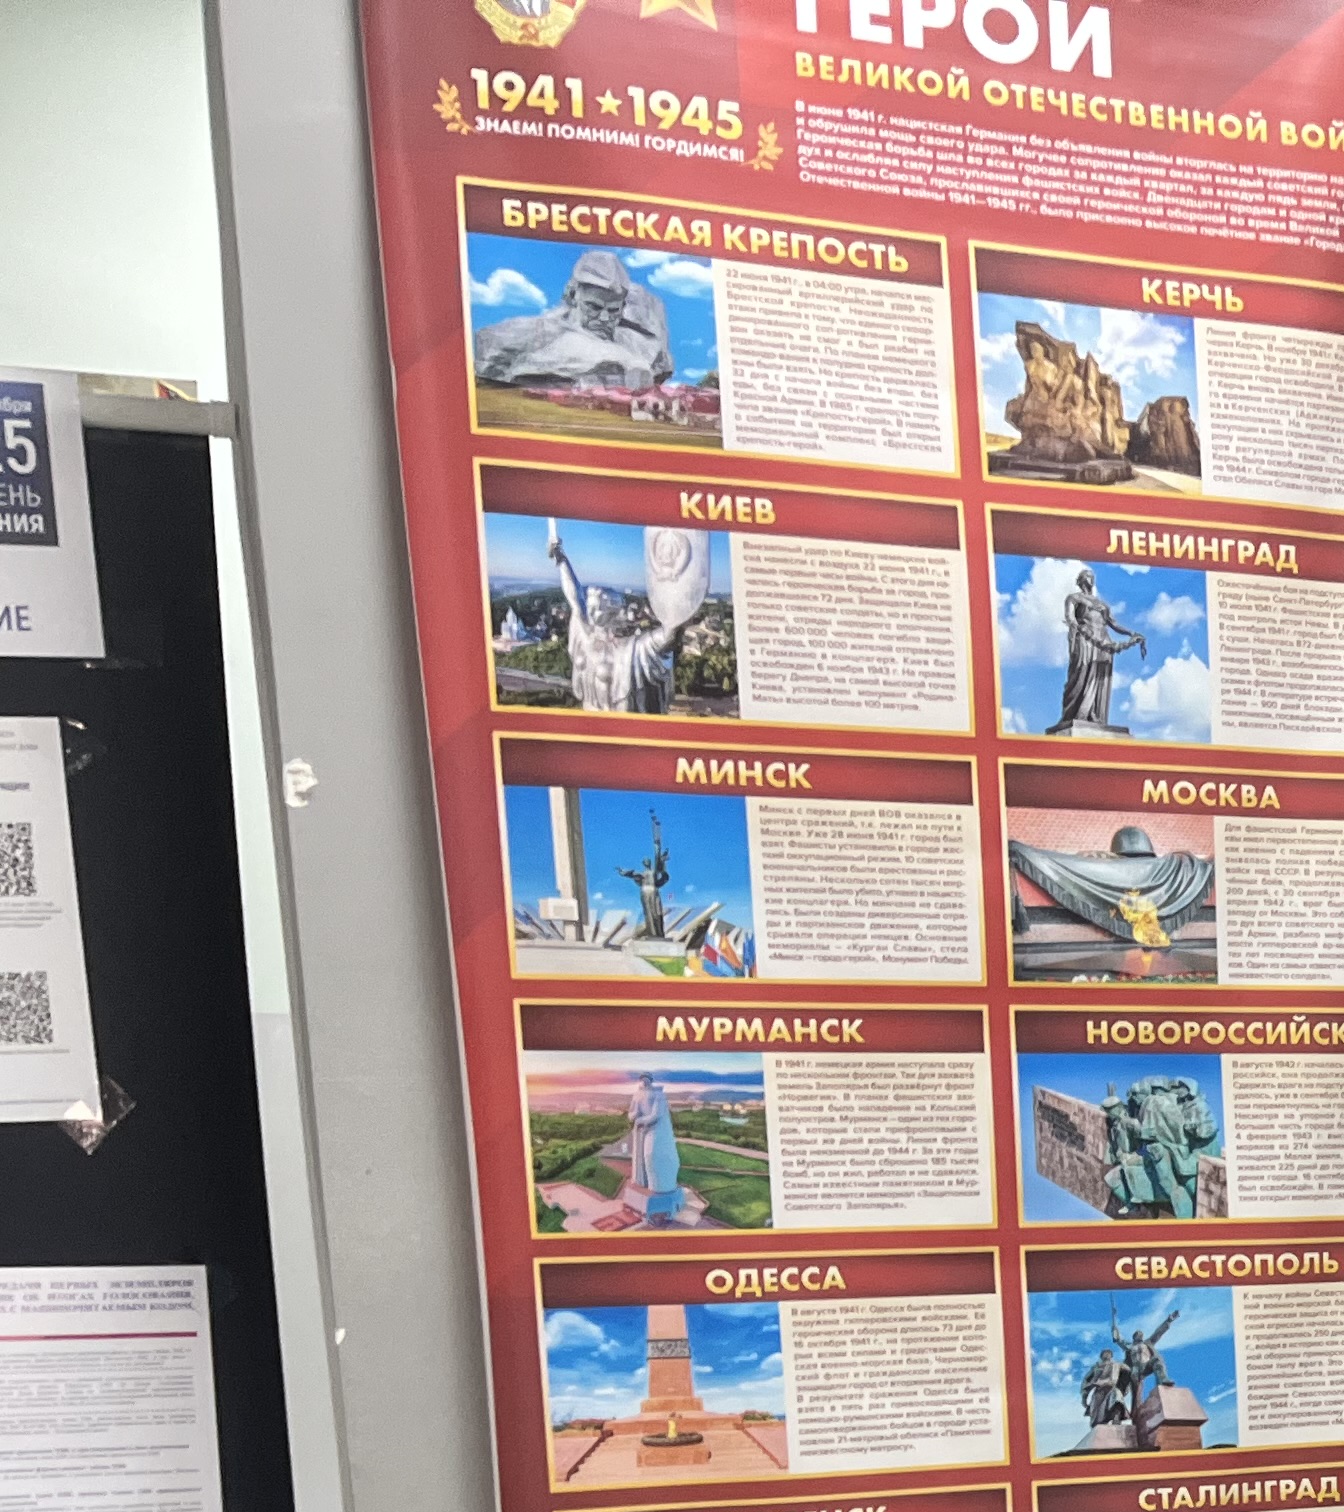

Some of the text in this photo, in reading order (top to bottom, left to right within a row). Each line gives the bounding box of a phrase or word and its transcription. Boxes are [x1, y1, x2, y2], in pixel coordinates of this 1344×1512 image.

[470, 67, 743, 139] 1941 1945
[795, 52, 970, 102] ВЕЛИКОЙ
[983, 80, 1267, 143] ОТЕЧЕСТВЕННОЙ
[501, 198, 909, 273] БРЕСТСКАЯ КРЕПОСТЬ
[1142, 277, 1244, 312] КЕРЧЬ
[0, 418, 37, 475] 5
[679, 491, 776, 524] КИЕВ
[1106, 528, 1299, 573] ЛЕНИНГРАД
[675, 757, 812, 790] МИНСК
[1142, 779, 1281, 809] МОСКВА
[655, 1015, 865, 1044] МУРМАНСК
[705, 1265, 846, 1298] ОДЕССА
[1115, 1251, 1339, 1280] СЕВАСТОПОЛЬ
[1138, 1476, 1341, 1511] СТАЛИНГРАД
